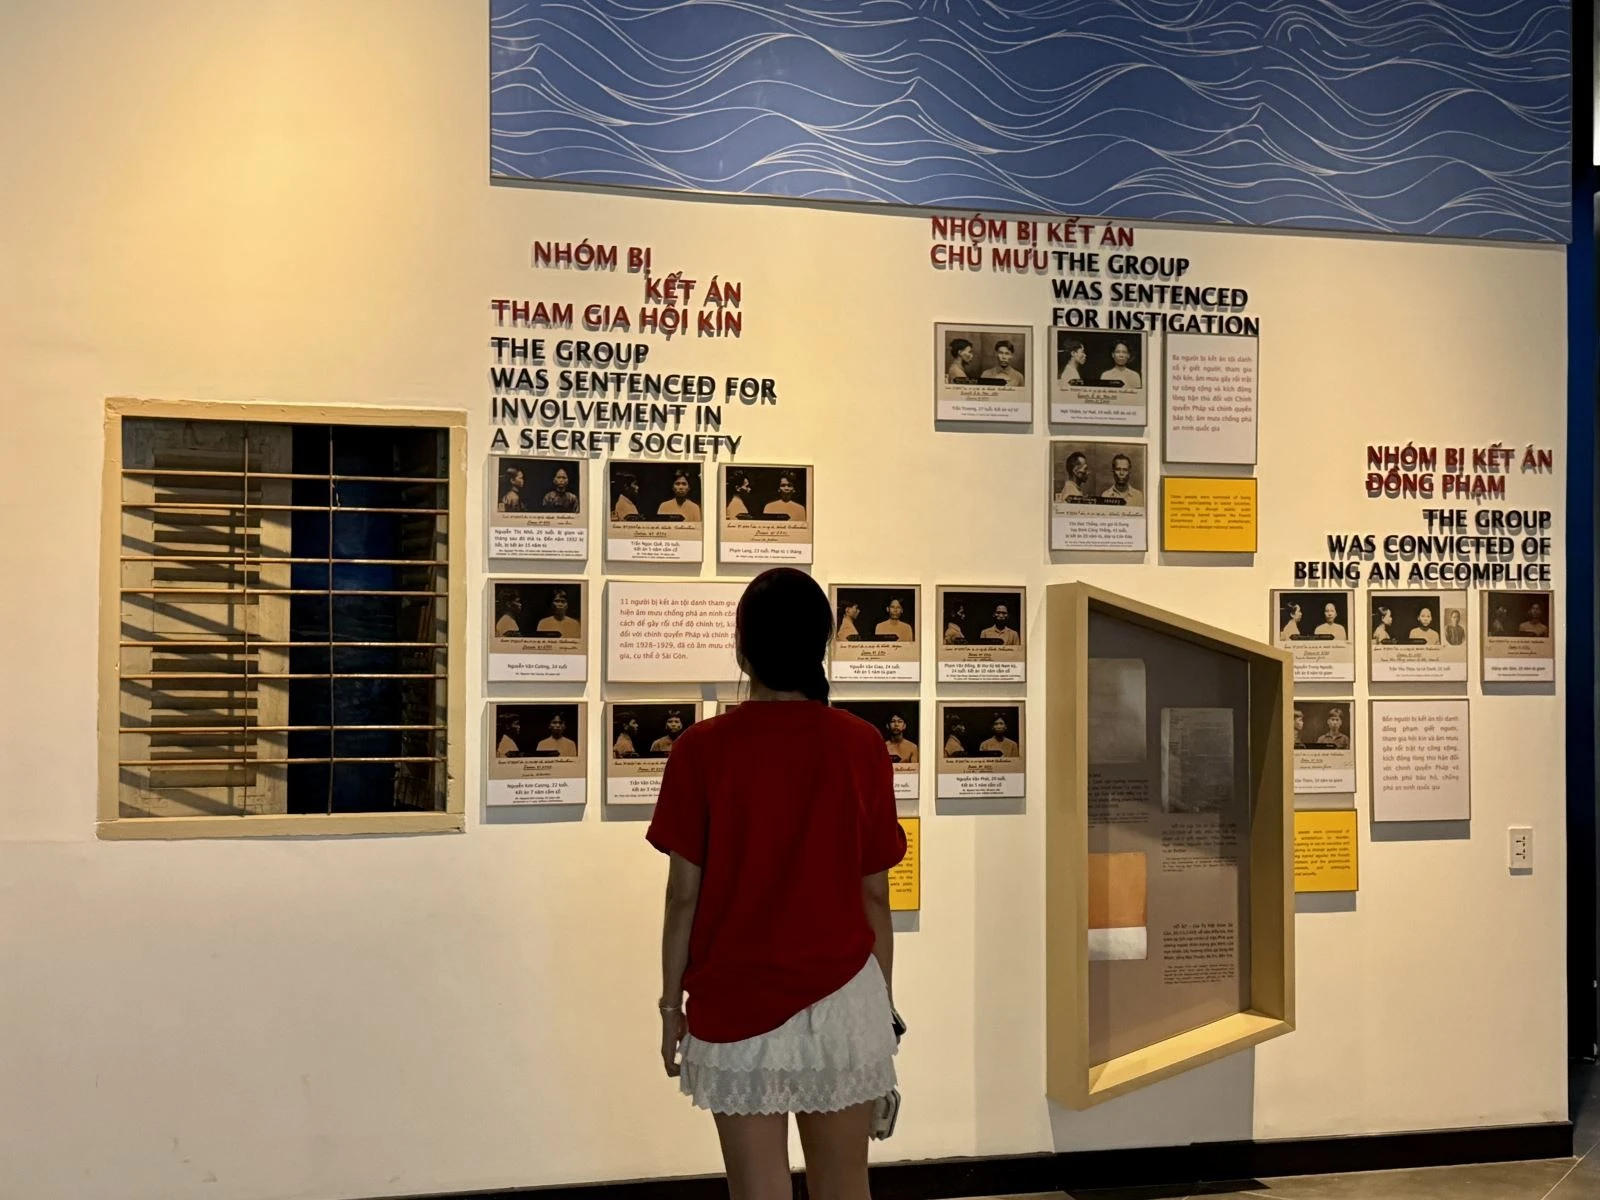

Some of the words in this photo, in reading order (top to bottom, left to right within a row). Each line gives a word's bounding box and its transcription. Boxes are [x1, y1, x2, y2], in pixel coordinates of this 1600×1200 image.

[932, 213, 1007, 240] NHÓM
[1017, 220, 1037, 248] BỊ
[1047, 216, 1095, 243] KẾT
[1101, 222, 1135, 247] ÁN
[534, 238, 617, 266] NHÓM
[628, 247, 651, 274] BỊ
[931, 240, 982, 267] CHỦ
[992, 247, 1048, 270] MƯU
[1052, 251, 1100, 273] THE
[1108, 254, 1190, 277] GROUP
[645, 271, 697, 300] KẾT
[707, 275, 741, 302] ÁN
[1052, 278, 1102, 301] WAS
[1110, 281, 1248, 308] SENTENCED
[491, 299, 573, 325] THAM
[584, 304, 630, 327] GIA
[641, 303, 688, 333] HỘI
[698, 306, 742, 332] KÍN
[1052, 307, 1099, 329] FOR
[1108, 310, 1259, 337] INSTIGATION
[491, 337, 546, 359] THE
[556, 340, 649, 364] GROUP
[491, 368, 549, 390] WAS
[559, 371, 716, 397] SENTENCED
[726, 378, 777, 398] FOR
[492, 397, 687, 425] INVOLVEMENT
[697, 405, 722, 425] IN
[491, 428, 509, 449] A
[520, 429, 621, 451] SECRET
[631, 433, 742, 455] SOCIETY
[1367, 443, 1437, 465] NHÓM
[1446, 447, 1465, 470] BỊ
[1472, 443, 1515, 467] KẾT
[1523, 446, 1552, 467] ÁN
[1366, 466, 1434, 492] ĐỒNG
[1442, 474, 1505, 497] PHẠM
[1423, 509, 1468, 528] THE
[1476, 510, 1551, 529] GROUP
[1328, 535, 1376, 553] WAS
[1384, 535, 1515, 555] CONVICTED
[1522, 537, 1551, 555] OF
[1294, 562, 1360, 580] BEING
[1370, 562, 1400, 580] AN
[1409, 562, 1551, 582] ACCOMPLICE
